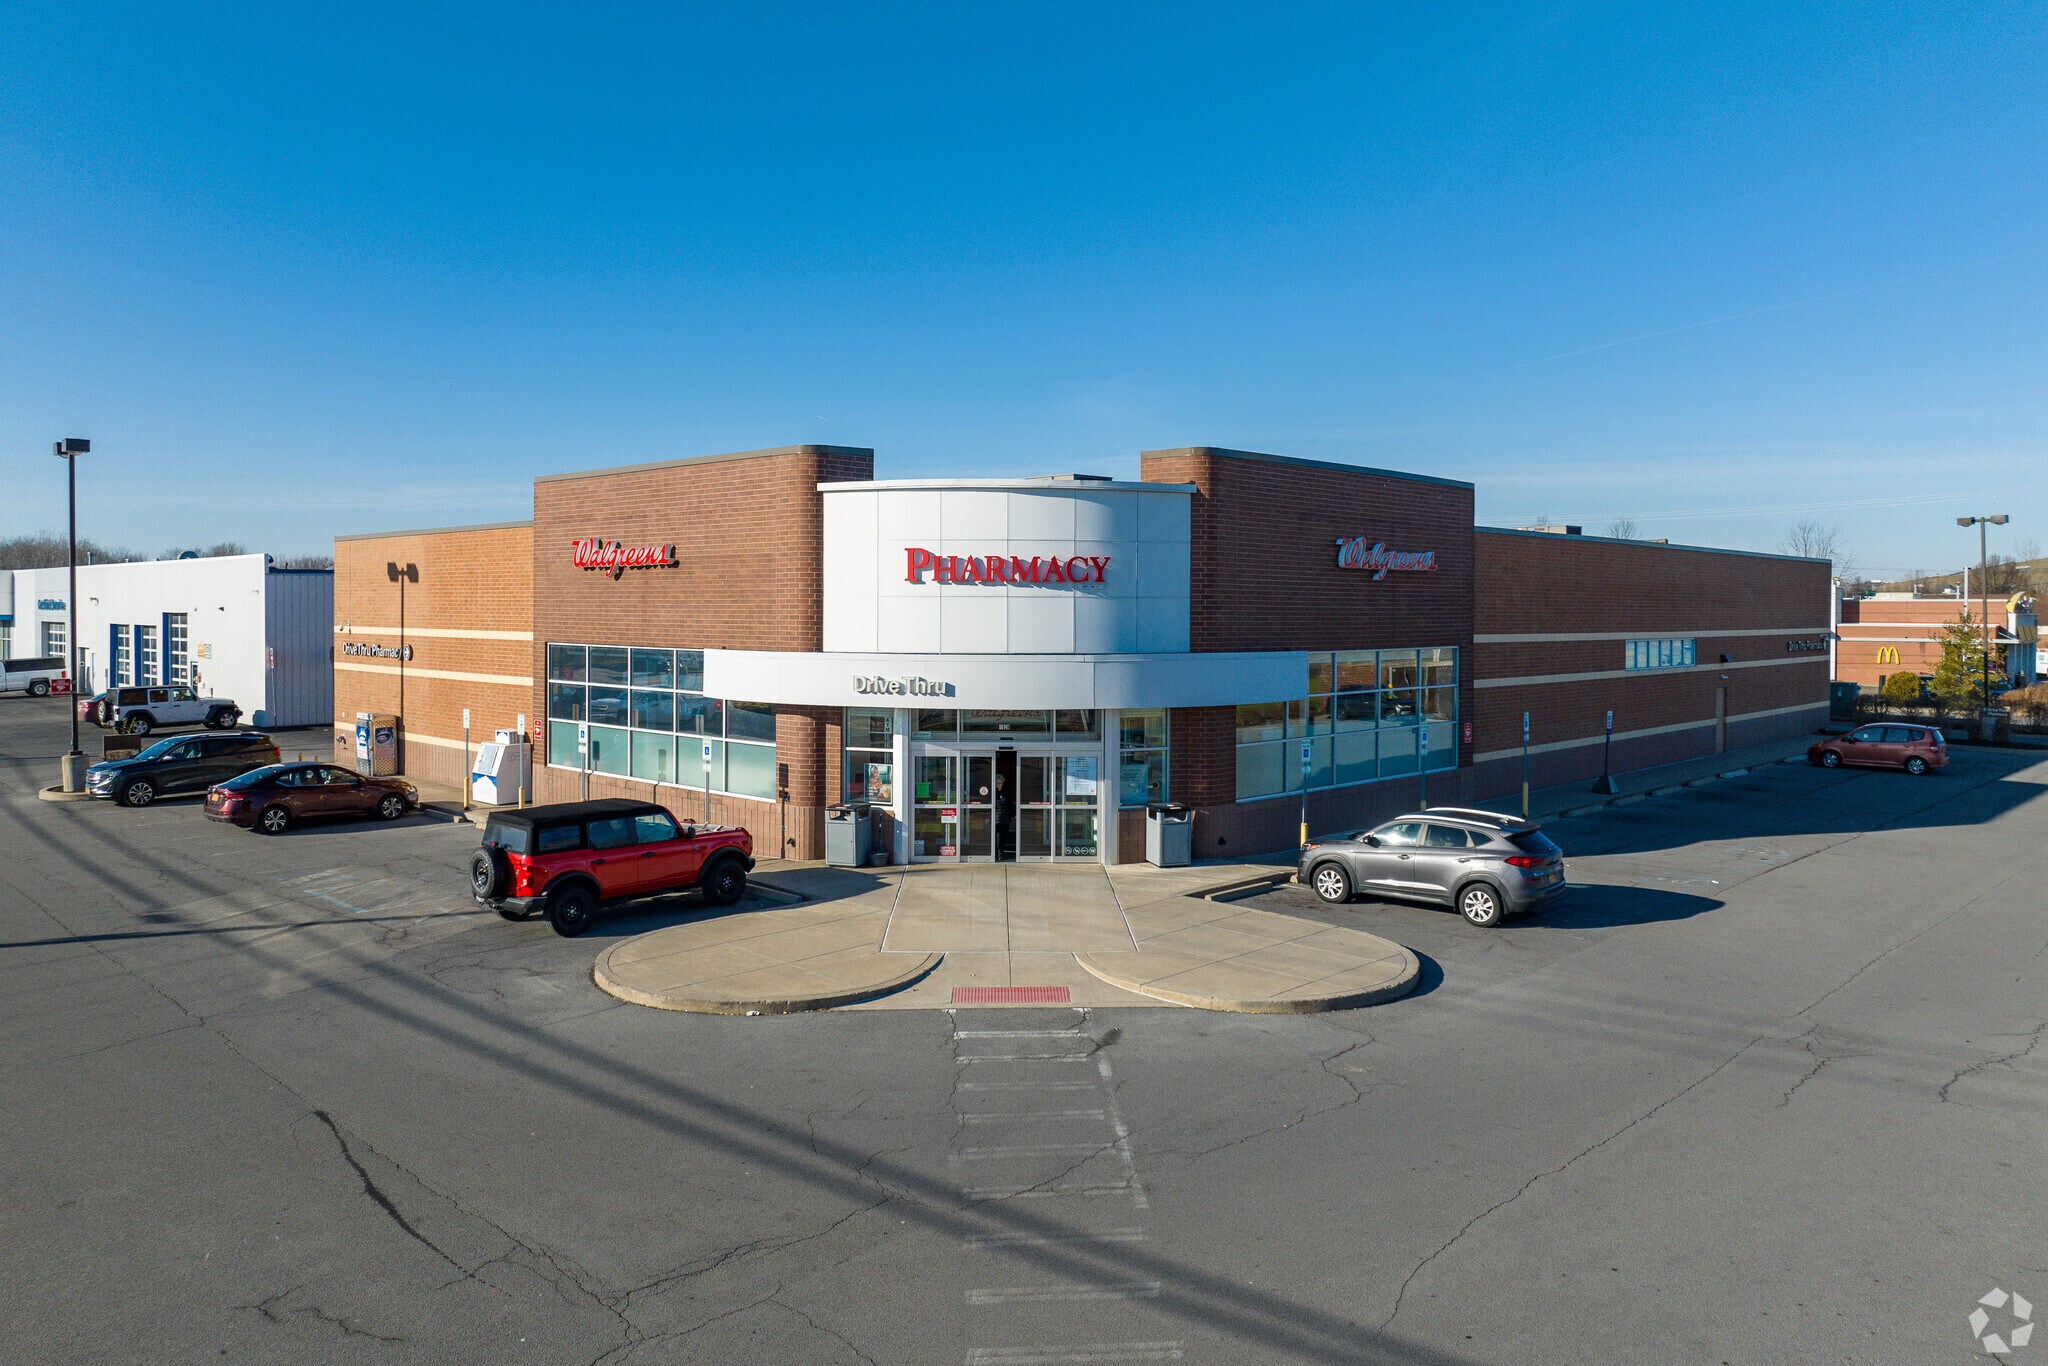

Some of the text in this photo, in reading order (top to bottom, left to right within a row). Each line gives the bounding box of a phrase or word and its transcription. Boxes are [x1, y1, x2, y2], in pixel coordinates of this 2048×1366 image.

[571, 537, 672, 578] Walgreens
[904, 547, 1111, 584] PHARMACY
[1337, 536, 1438, 580] Walgreens
[342, 642, 402, 660] Drive Thru Pharmacy
[853, 675, 947, 695] Drive Thru
